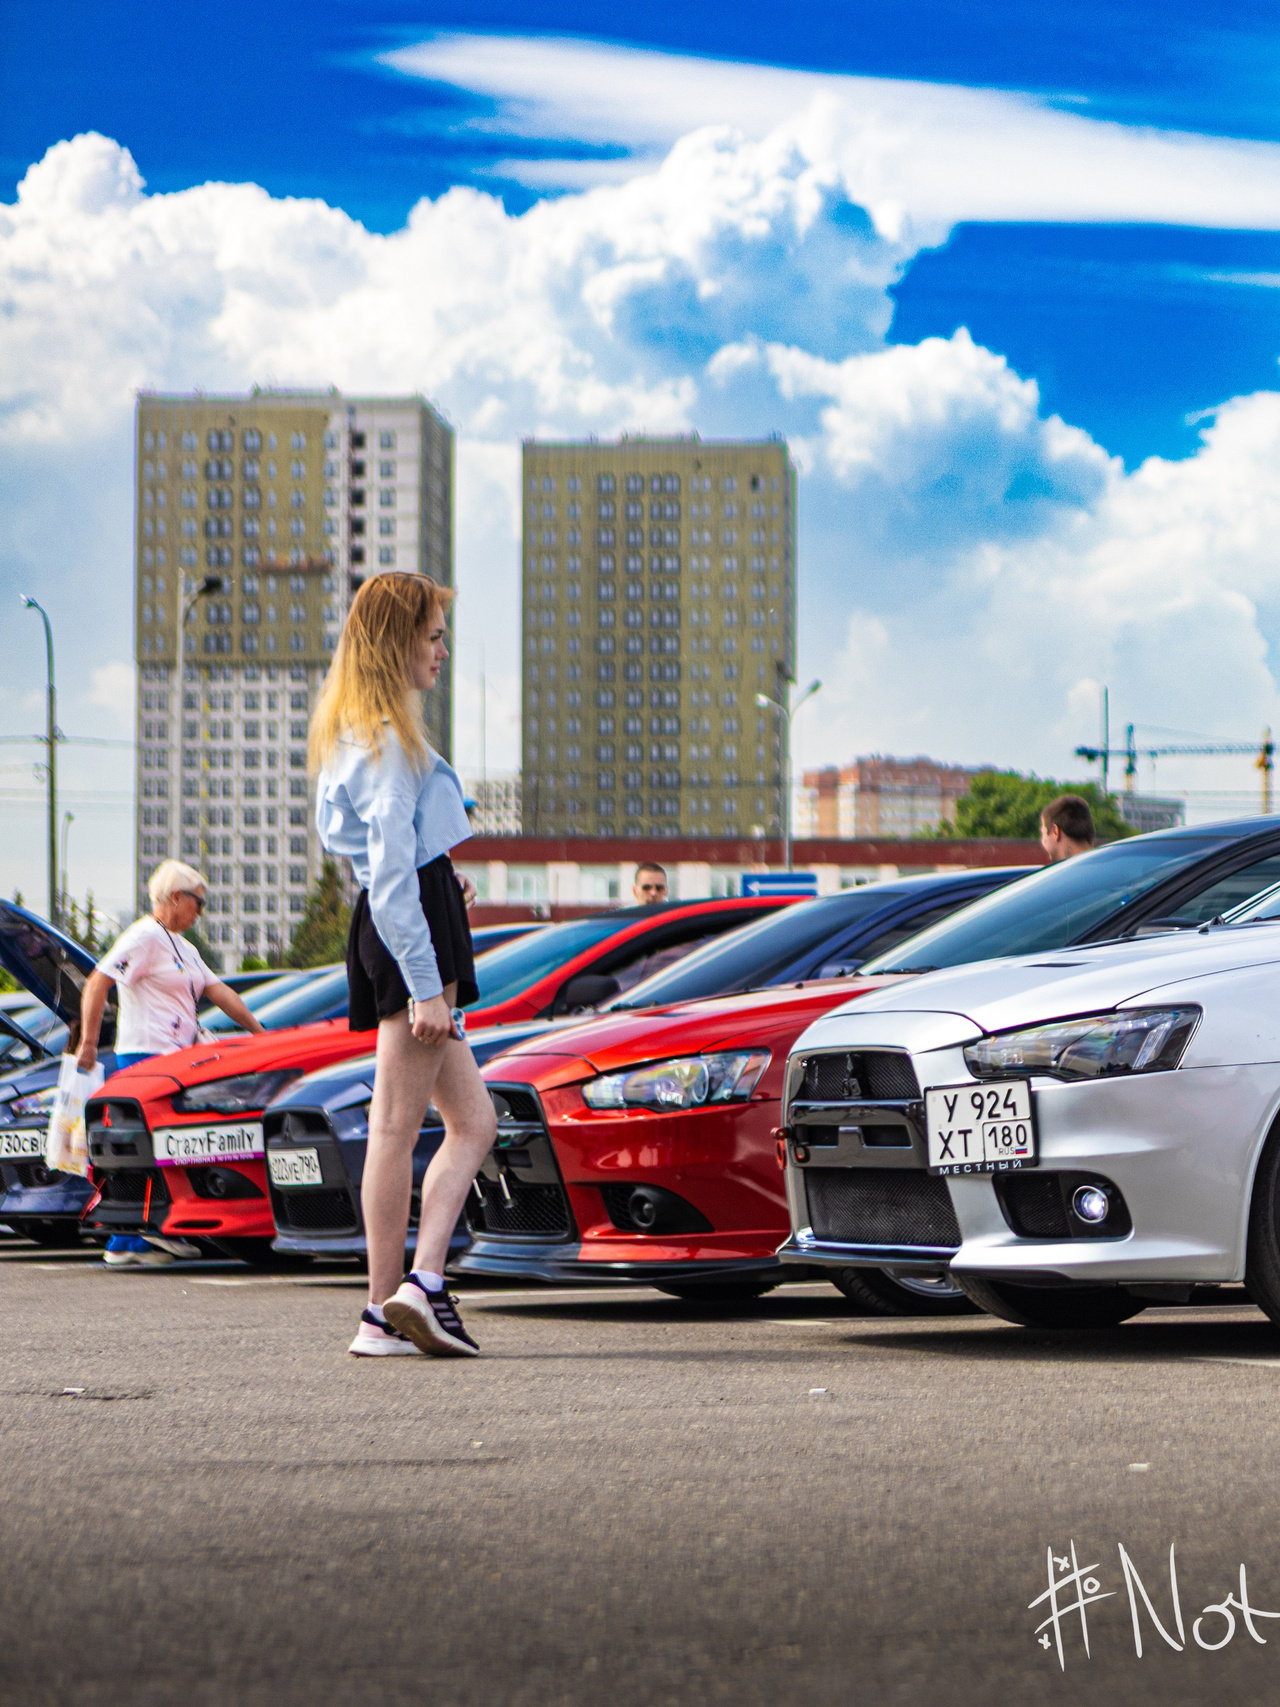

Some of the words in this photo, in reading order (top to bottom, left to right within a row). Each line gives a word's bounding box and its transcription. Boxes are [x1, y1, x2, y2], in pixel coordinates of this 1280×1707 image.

[944, 1093, 959, 1123] У
[971, 1088, 1017, 1120] 924
[167, 1128, 255, 1157] CrazyFamily
[938, 1128, 973, 1160] ХТ
[988, 1124, 1028, 1148] 180
[998, 1147, 1015, 1156] RUS
[939, 1159, 1022, 1175] МЕСТНЫЙ
